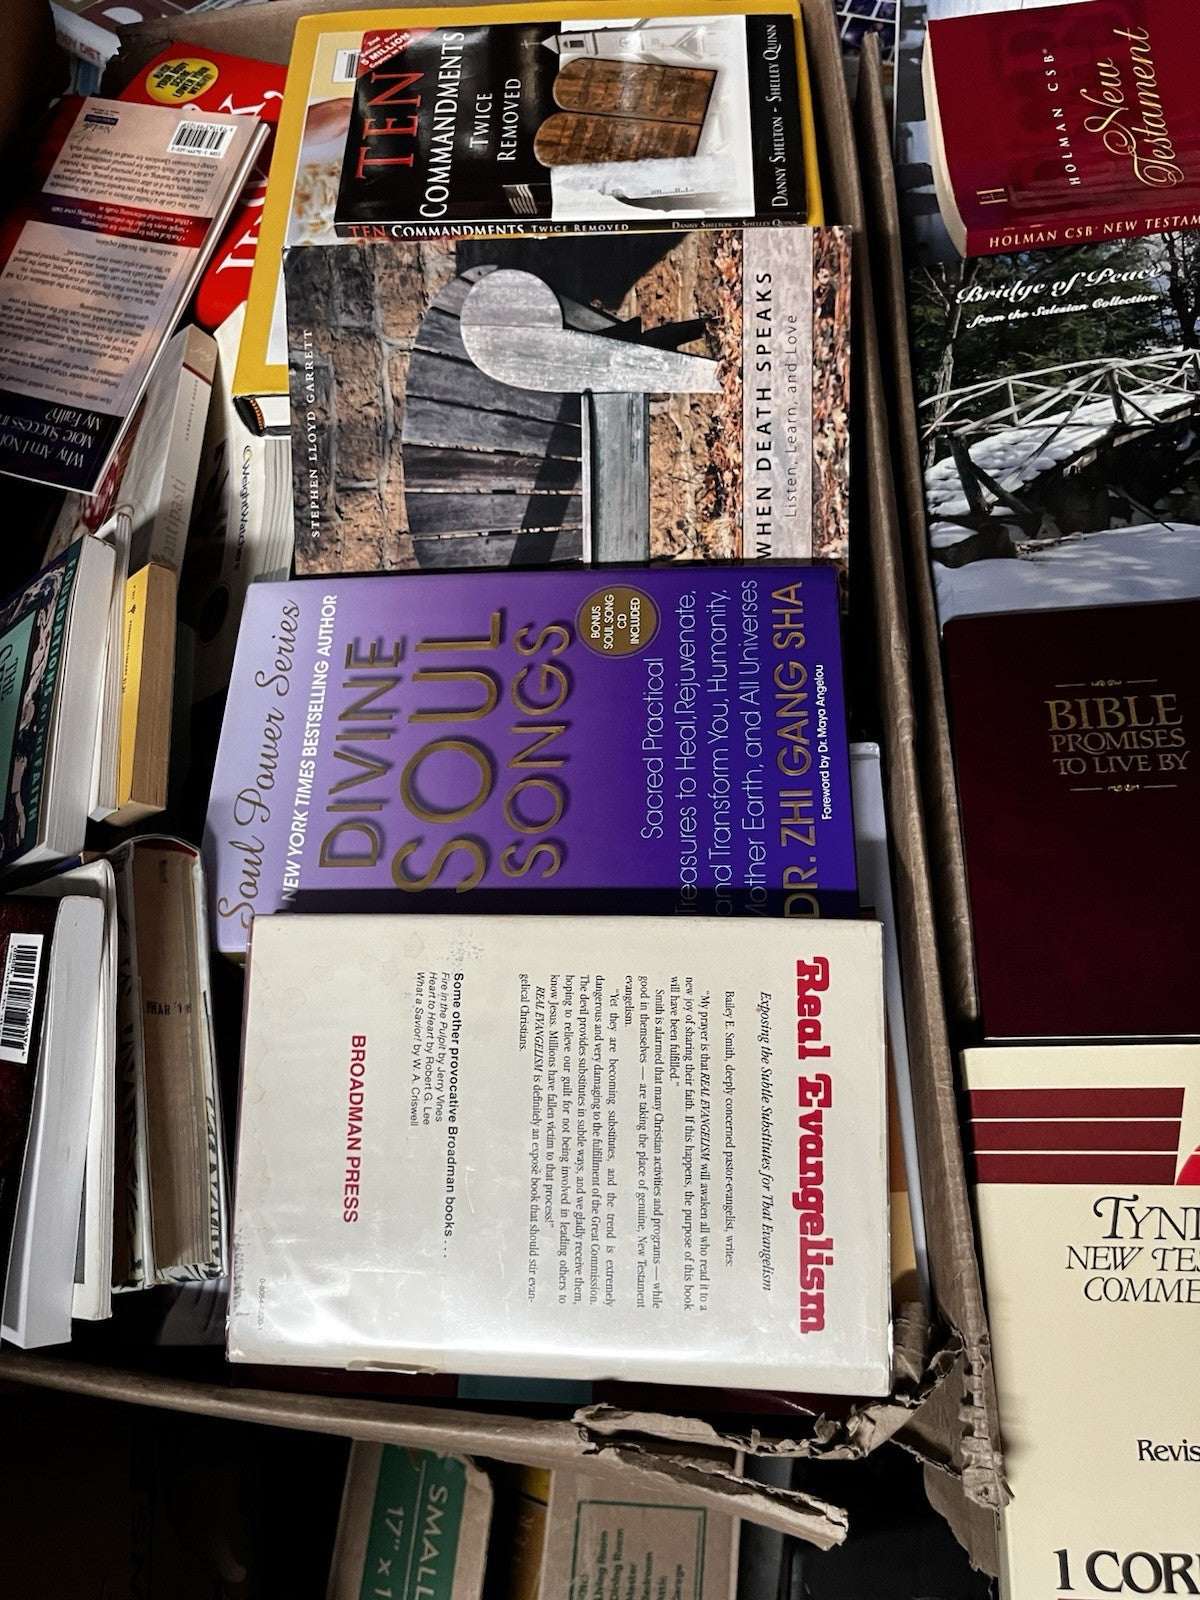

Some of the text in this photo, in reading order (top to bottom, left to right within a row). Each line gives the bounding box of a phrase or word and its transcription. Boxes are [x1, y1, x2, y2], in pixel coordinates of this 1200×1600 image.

[369, 32, 409, 60] MILLION
[762, 24, 782, 60] QUINN
[765, 62, 782, 102] SHELLEY
[1080, 57, 1137, 156] New
[1112, 26, 1185, 188] Testament
[355, 72, 424, 179] TEN
[420, 32, 464, 218] COMMANDMENTS
[470, 93, 492, 148] TWICE
[497, 78, 522, 162] REMOVED
[769, 116, 786, 162] SHELTON
[1052, 108, 1082, 186] HOLMAN
[772, 167, 788, 206] DANNY
[990, 230, 1058, 248] HOLMAN
[1103, 220, 1138, 234] NEW
[955, 267, 1164, 304] Bridge of Peace
[966, 294, 1160, 329] from the Salesian Collection
[12, 416, 62, 442] Success
[45, 408, 101, 431] My Faith?
[62, 429, 94, 448] More
[303, 329, 320, 538] STEPHEN LLOYD GARRETT
[756, 272, 772, 559] WHEN DEATH SPEAKS
[784, 314, 800, 518] Listen, Learn, and Love
[22, 440, 30, 454] I
[31, 442, 54, 458] Am
[56, 446, 84, 468] Why
[164, 476, 186, 557] antipasti
[234, 456, 252, 572] WeightWatchers
[43, 557, 78, 698] FOUNDATIONS
[590, 605, 600, 638] BONUS
[604, 594, 614, 650] SOUL SONG
[617, 614, 626, 629] CD
[630, 597, 640, 644] INCLUDED
[737, 580, 762, 674] Universes
[739, 681, 761, 705] All
[1044, 694, 1183, 731] BIBLE
[281, 594, 338, 901] NEW YORK TIMES BESTSELLING AUTHOR
[318, 640, 400, 868] DIVINE
[391, 610, 501, 893] SOUL
[500, 624, 570, 878] SONGS
[640, 657, 664, 839] Sacred Practical
[674, 590, 700, 914] Treasures to Heal, Rejuvenate,
[706, 589, 733, 916] and Transform You, Humanity,
[740, 711, 762, 758] and
[770, 581, 820, 919] DR. ZHI GANG SHA
[814, 664, 833, 820] Foreword by Dr. Maya Angelou
[1050, 728, 1186, 755] PROMISES
[28, 757, 43, 822] FAITH
[217, 598, 300, 929] Soul Power Series
[1052, 750, 1192, 776] TO LIVE BY
[740, 764, 766, 830] Earth,
[415, 972, 425, 997] What
[412, 1044, 423, 1056] by
[414, 1007, 424, 1041] Savior!
[435, 972, 450, 1122] Fire in the Pulpit by Jerry Vines
[412, 1074, 421, 1084] A.
[413, 1058, 422, 1071] W.
[343, 1034, 366, 1223] BROADMAN PRESS
[410, 1087, 420, 1127] Criswell
[444, 972, 464, 1237] Some other provocative Broadman books
[723, 990, 736, 1266] Bailey E. Smith, deeply concerned pastor-evangelist, writes:
[756, 992, 774, 1291] Exposing the Subtle Substitutes for That Evangelism
[792, 956, 834, 1334] Real Evangelism
[1065, 1245, 1200, 1272] NEW TE
[1137, 1439, 1200, 1462] Revis
[413, 1484, 448, 1600] SMALL
[1053, 1549, 1200, 1595] 1 COR
